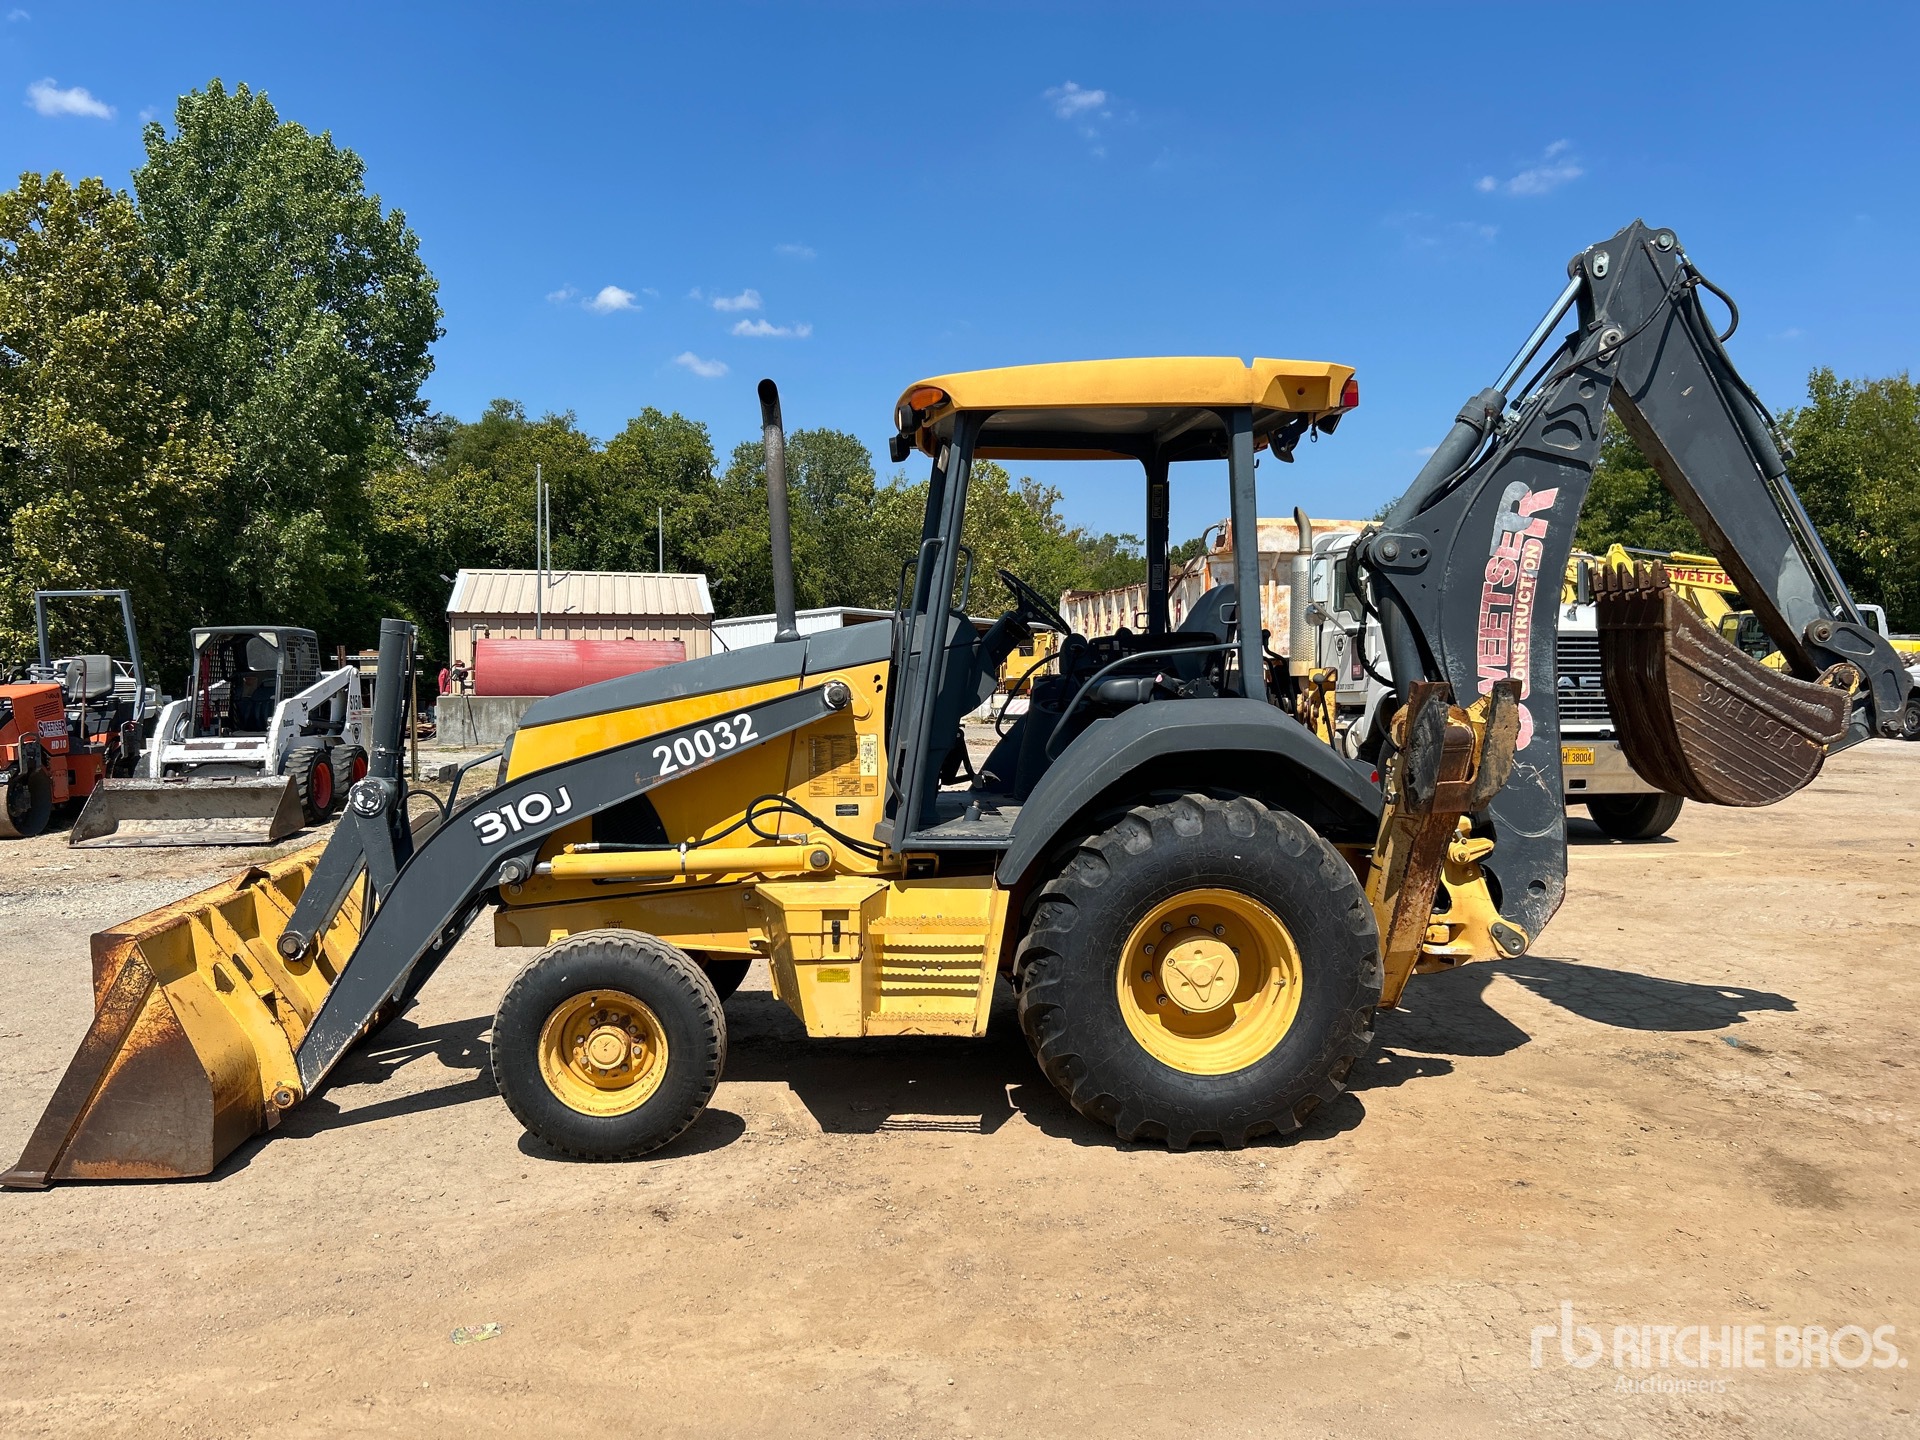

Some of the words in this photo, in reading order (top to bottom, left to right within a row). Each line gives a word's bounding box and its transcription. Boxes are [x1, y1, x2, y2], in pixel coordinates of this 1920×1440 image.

[652, 713, 759, 776] 20032
[1697, 681, 1806, 758] SWEETSER
[1572, 752, 1592, 762] 38004
[473, 785, 573, 845] 310J
